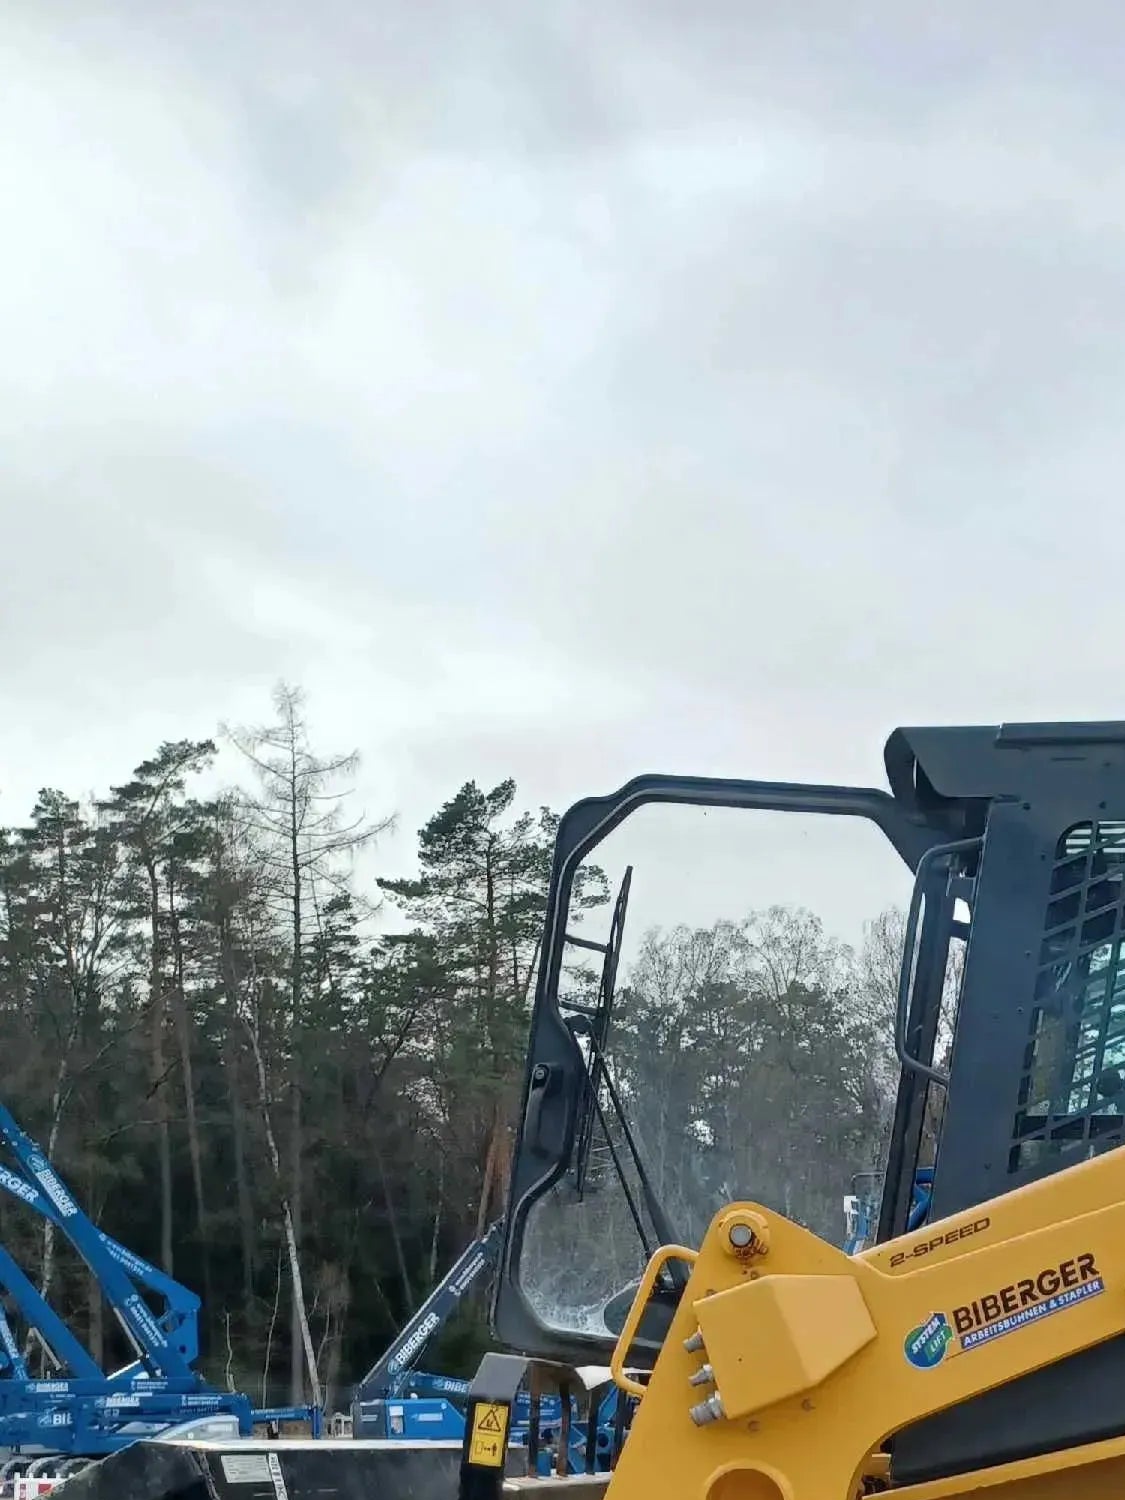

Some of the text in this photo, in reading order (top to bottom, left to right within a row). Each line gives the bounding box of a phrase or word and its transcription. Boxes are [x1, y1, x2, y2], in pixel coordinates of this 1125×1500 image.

[889, 1217, 991, 1268] 2-SPEED
[952, 1252, 1100, 1334] BIBERGER
[1057, 1279, 1101, 1306] STAPLER
[394, 1311, 441, 1366] BIBERGER
[444, 1379, 467, 1393] BIBE
